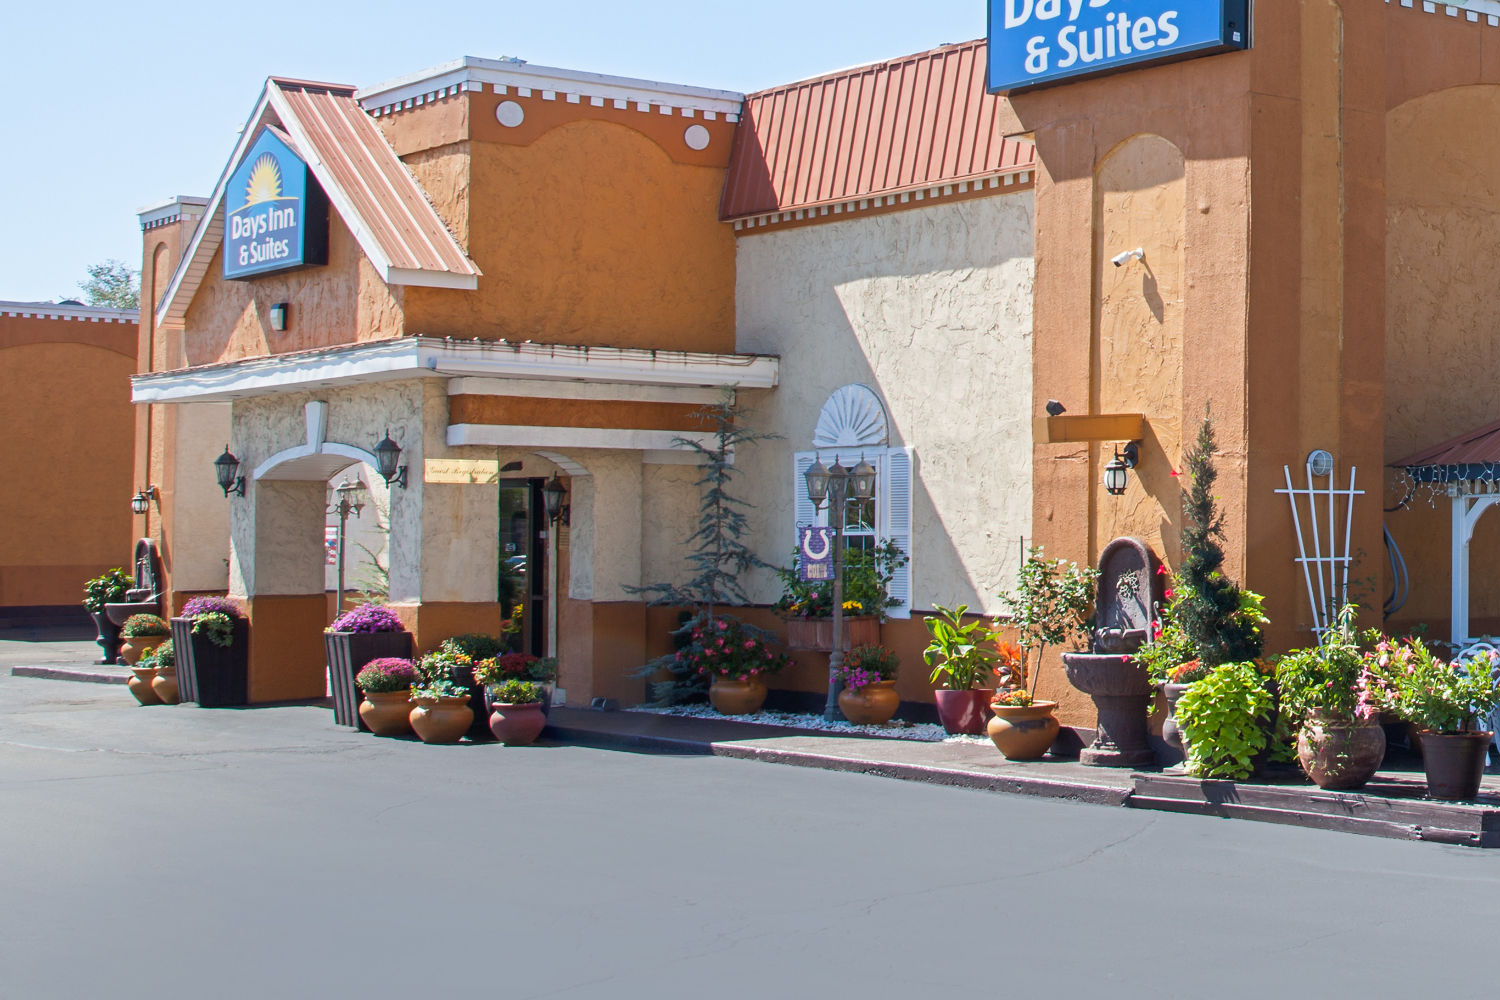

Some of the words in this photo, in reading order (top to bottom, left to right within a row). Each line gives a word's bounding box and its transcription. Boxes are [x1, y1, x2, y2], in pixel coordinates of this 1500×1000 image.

[1024, 35, 1050, 75] &
[1057, 10, 1180, 69] Suites
[232, 212, 267, 241] Days
[268, 207, 296, 232] Inn
[239, 244, 250, 266] &
[250, 236, 289, 265] Suites
